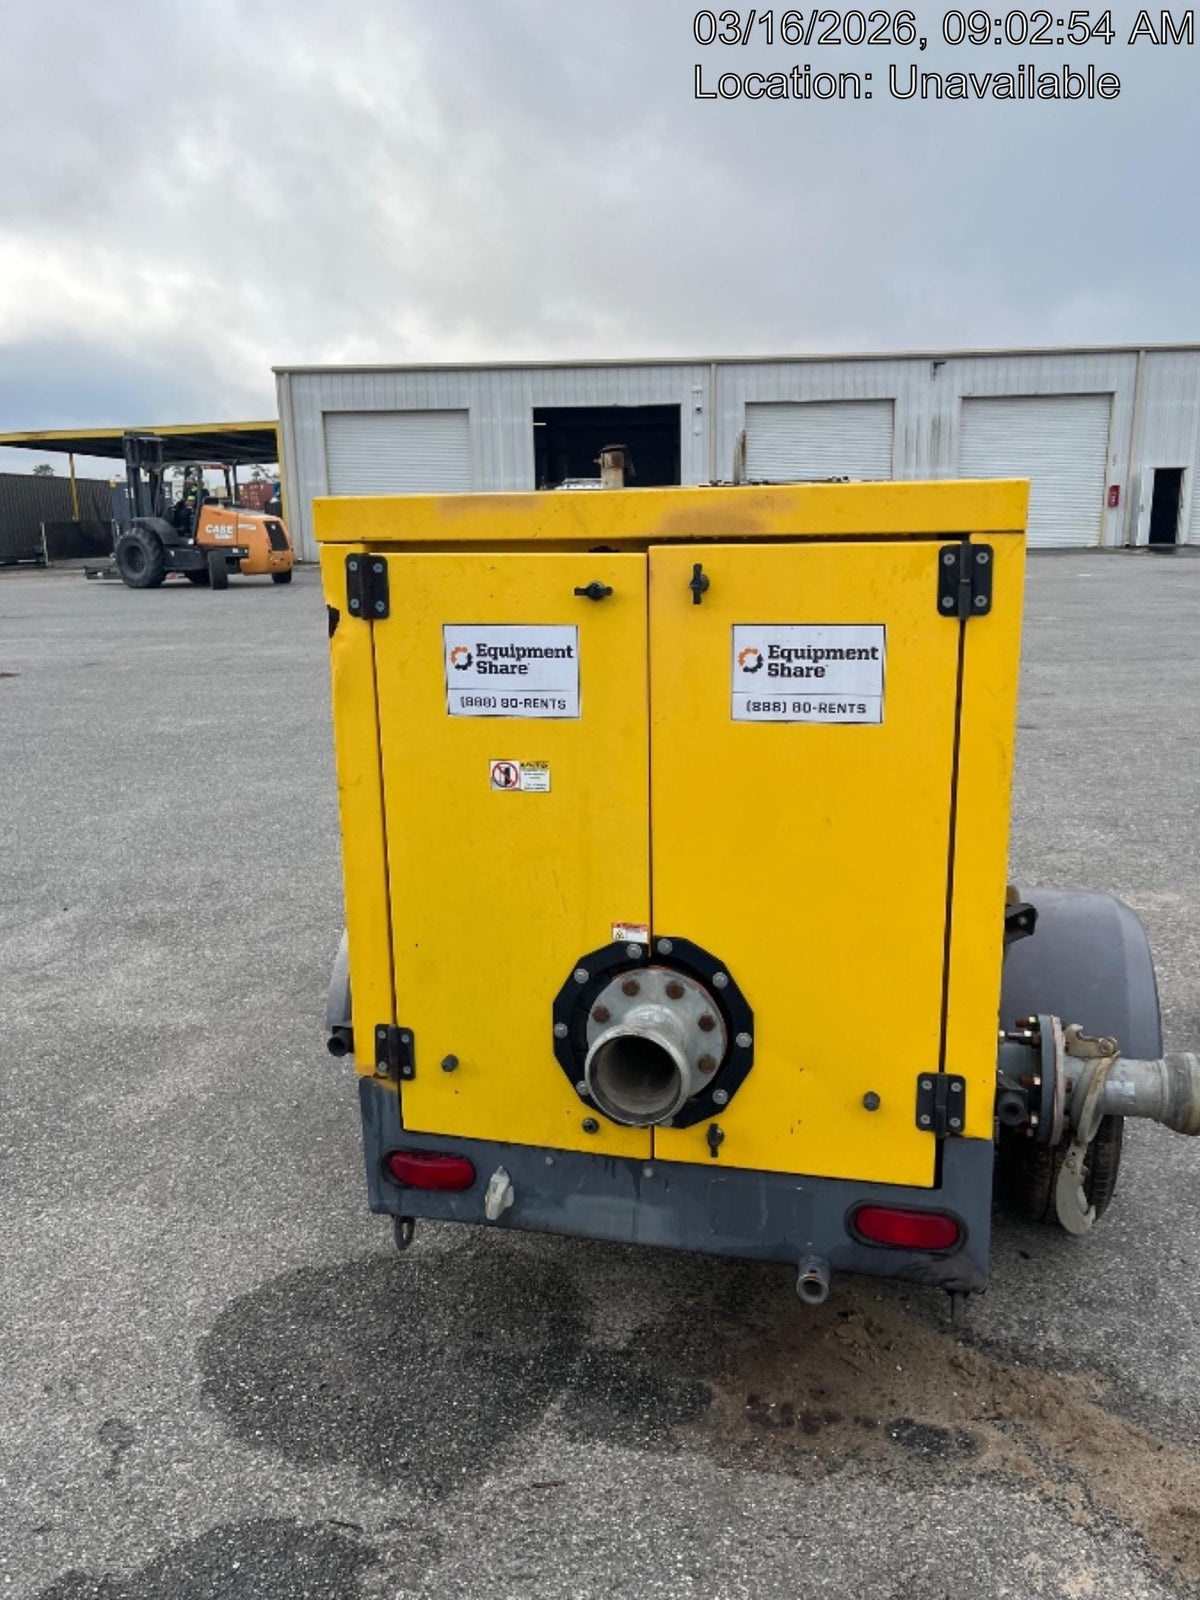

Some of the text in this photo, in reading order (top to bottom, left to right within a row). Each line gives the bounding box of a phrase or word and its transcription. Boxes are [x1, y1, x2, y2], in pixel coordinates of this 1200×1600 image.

[205, 523, 234, 535] CASE
[475, 643, 574, 661] Equipment
[767, 645, 879, 663] Equipment
[476, 661, 529, 675] Share
[767, 662, 826, 678] Share
[460, 696, 497, 708] (888)
[746, 700, 787, 713] (888)
